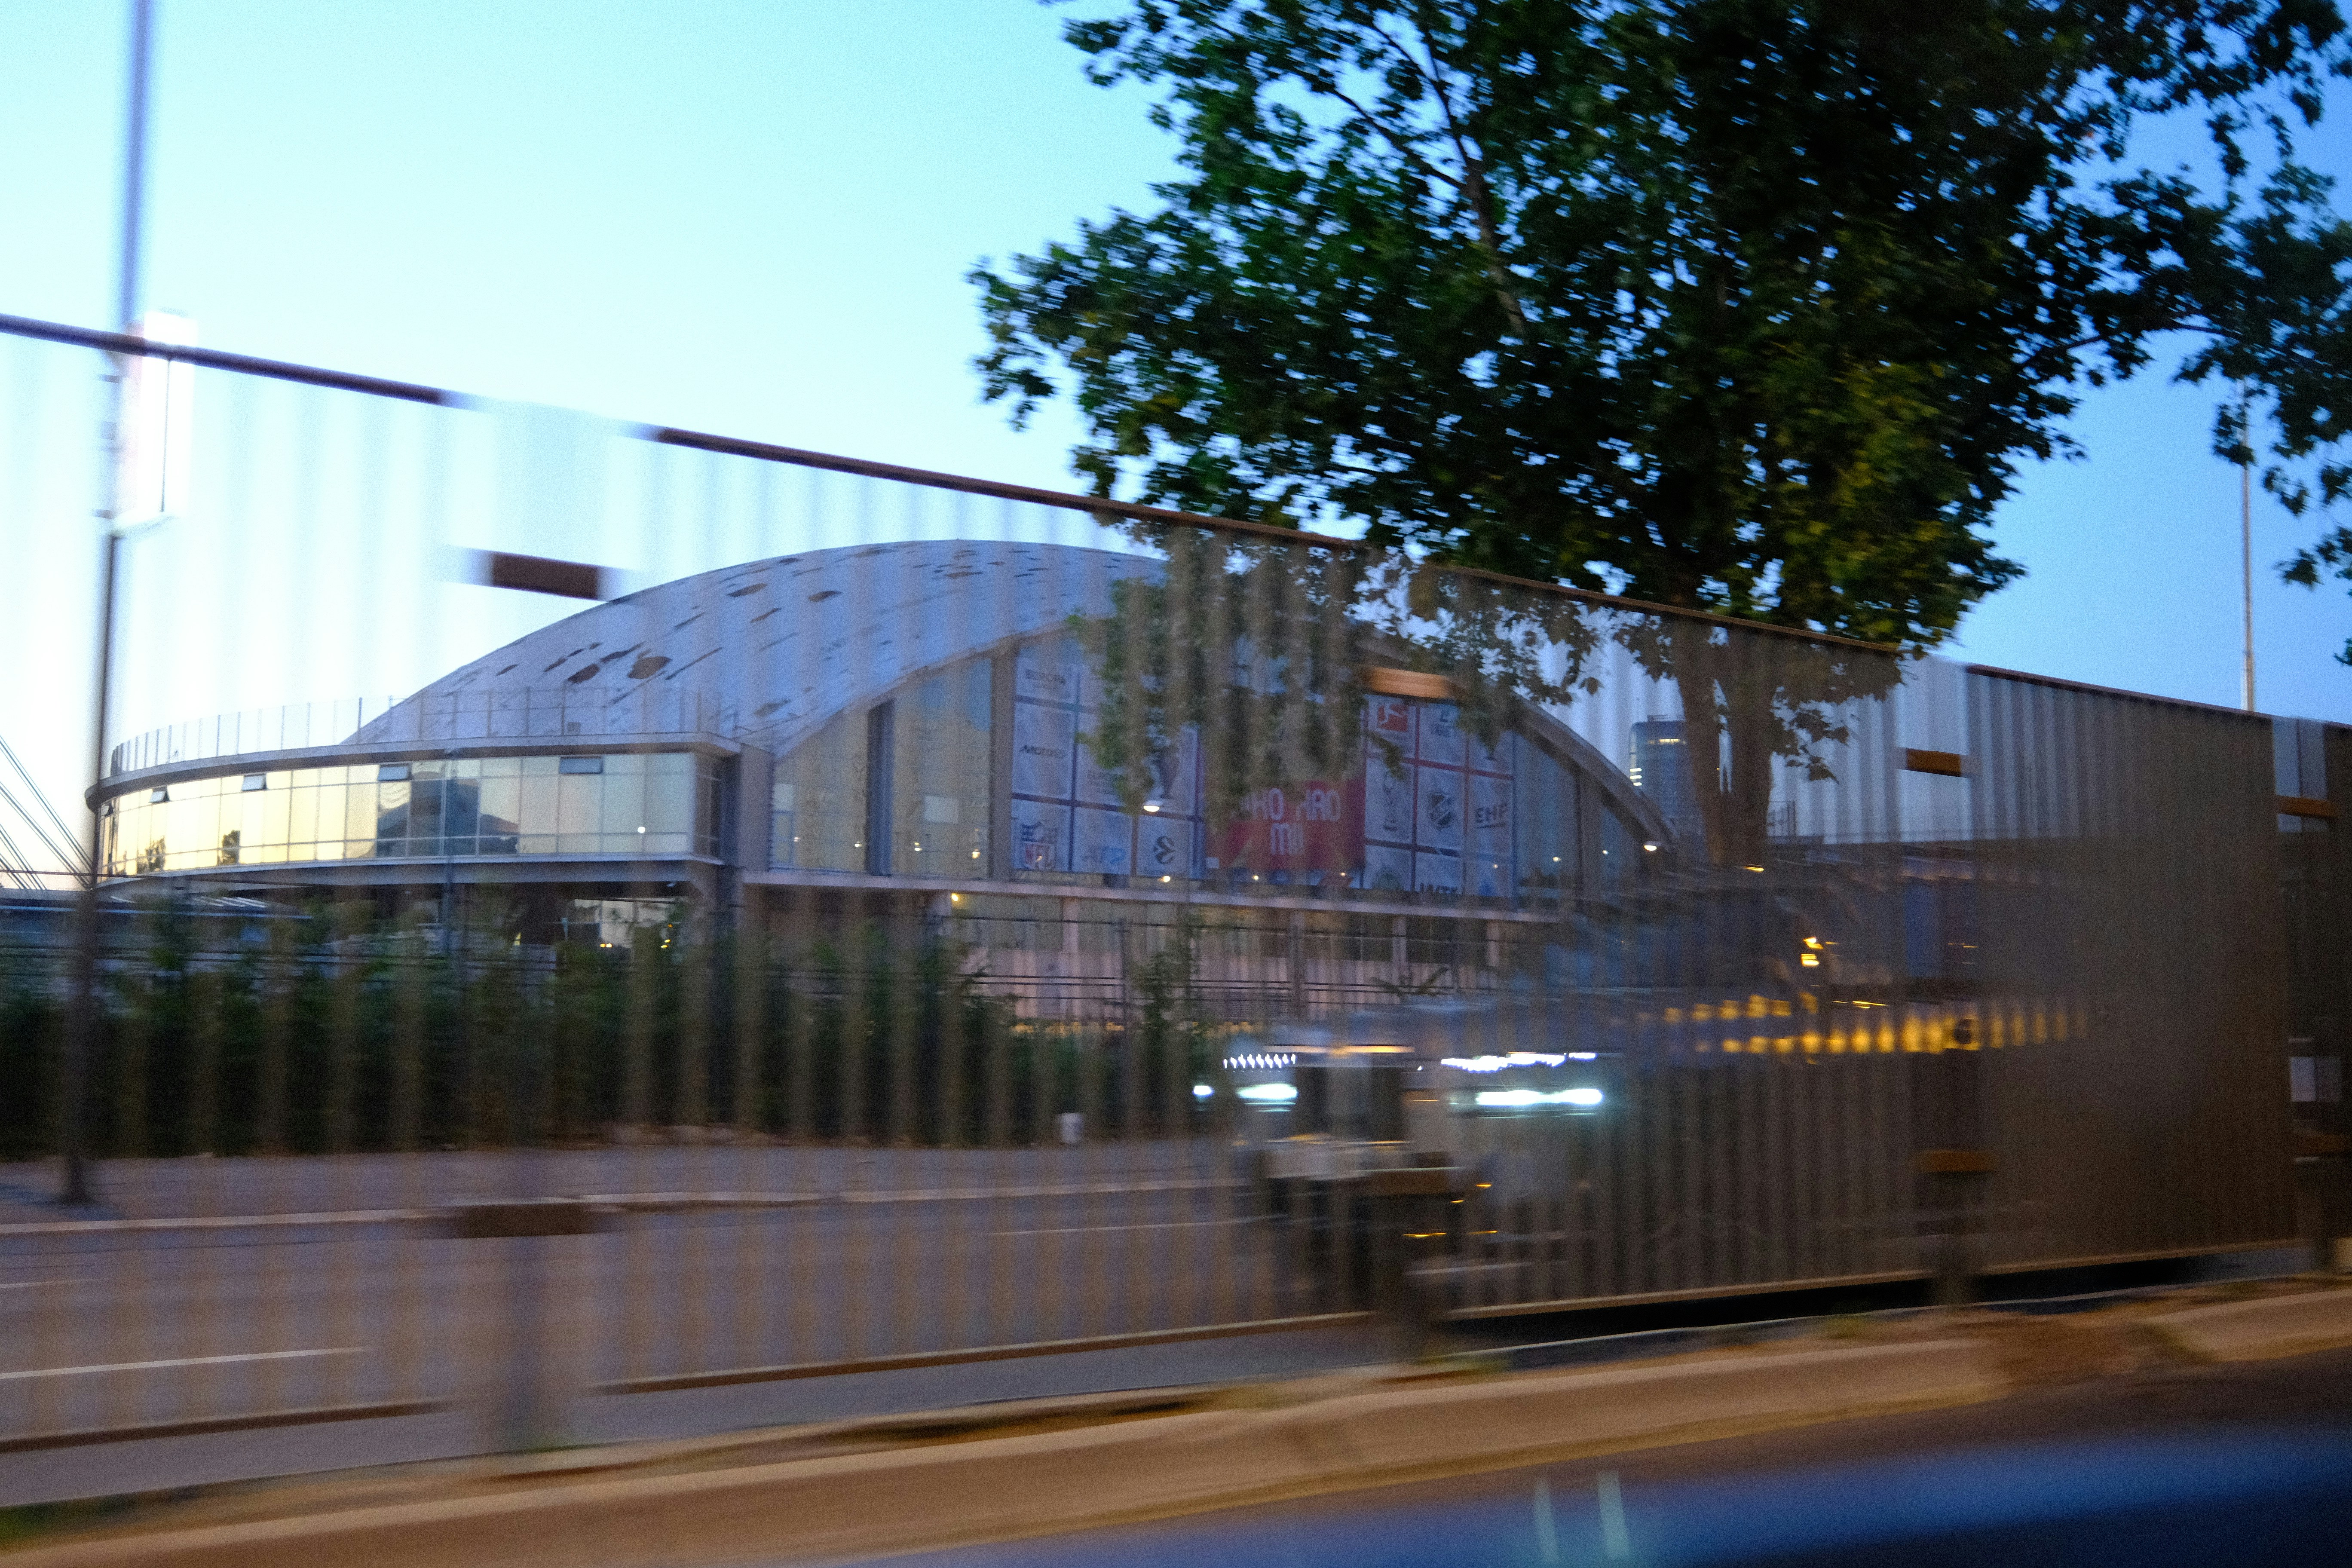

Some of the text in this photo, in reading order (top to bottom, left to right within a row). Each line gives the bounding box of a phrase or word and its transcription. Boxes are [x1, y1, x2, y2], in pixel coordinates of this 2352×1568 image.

[1475, 802, 1507, 824] EHF
[1025, 844, 1053, 869] NFL
[1083, 844, 1126, 864] ATP
